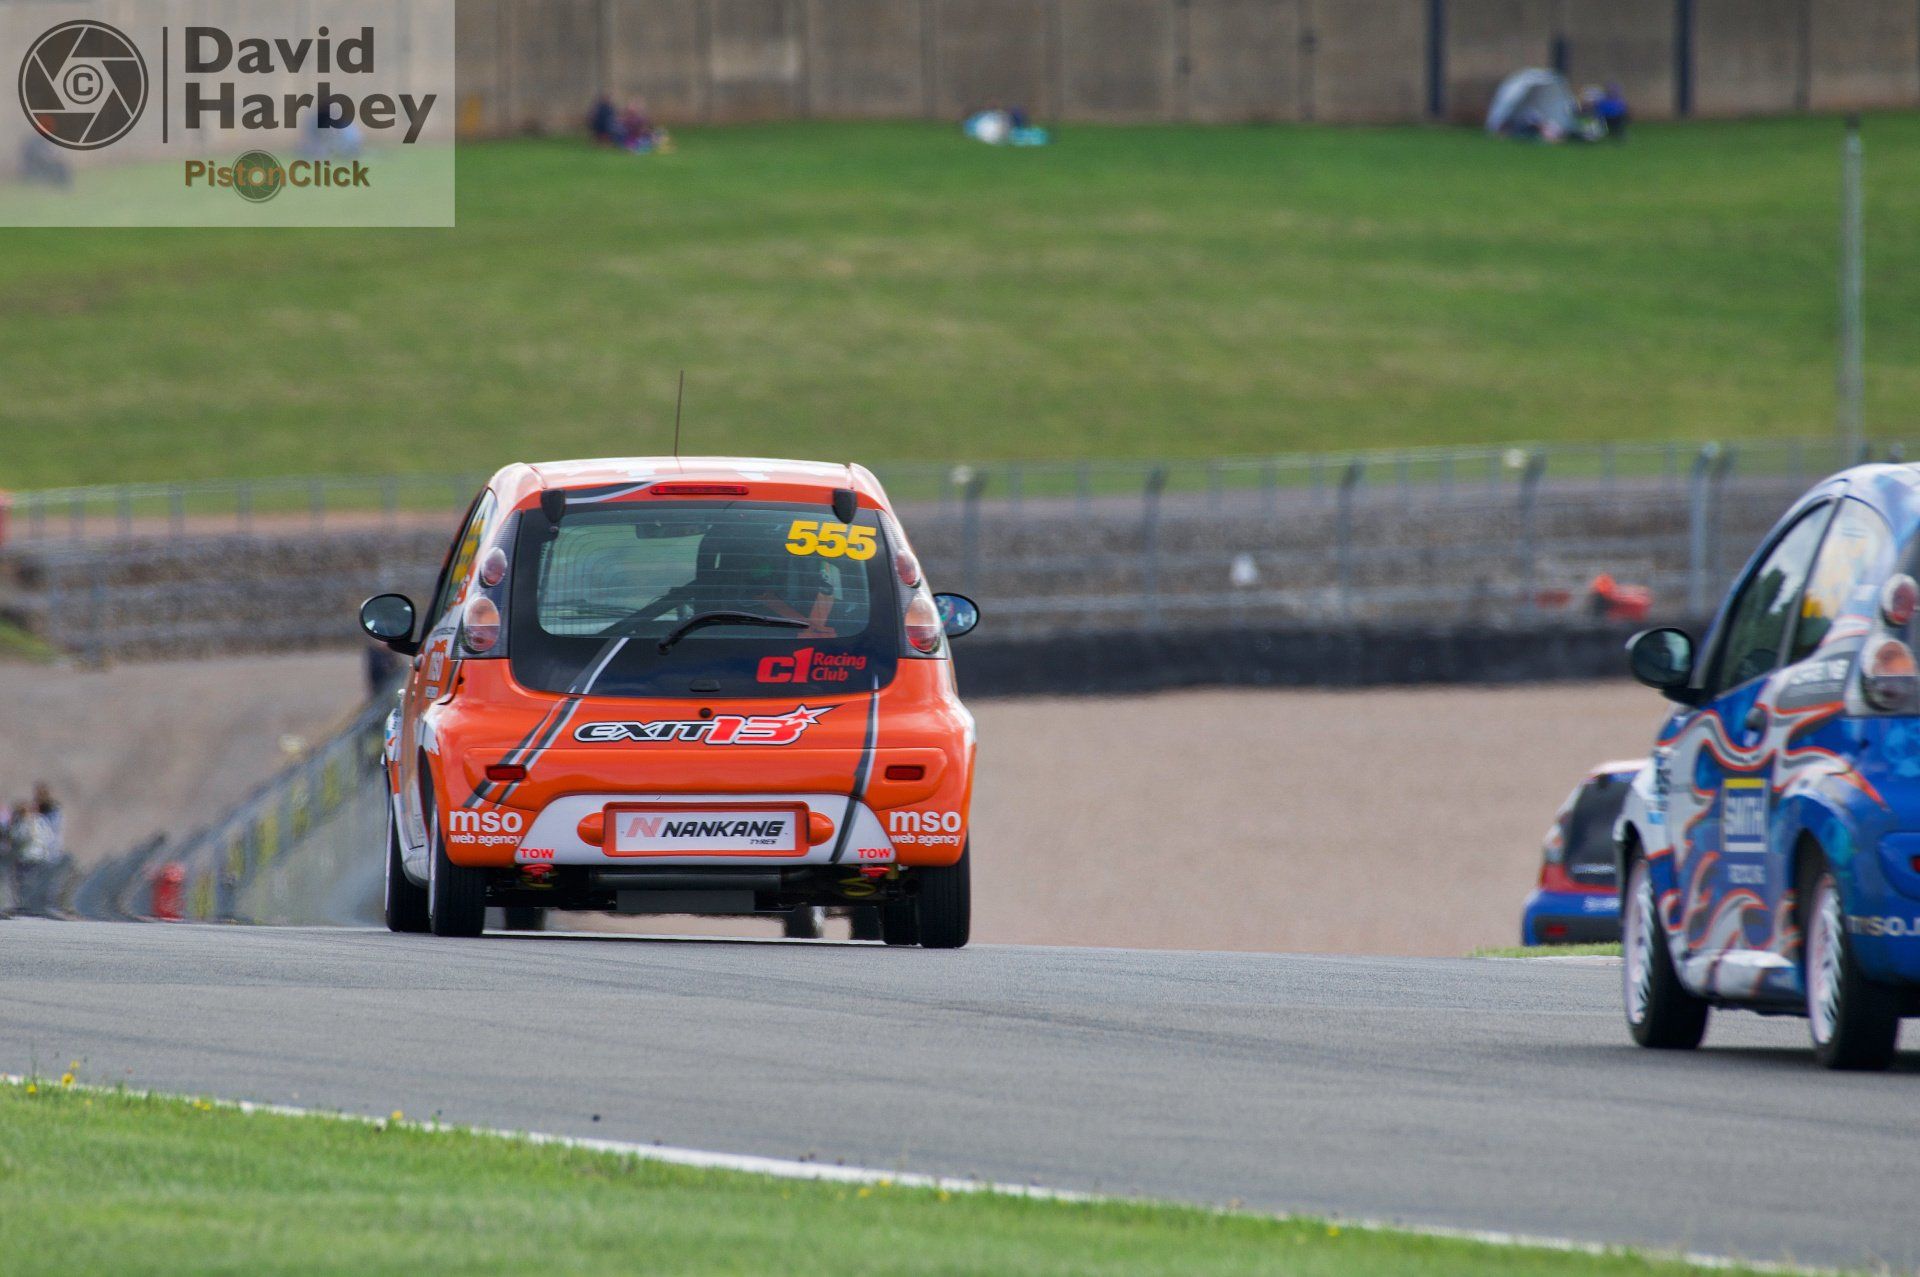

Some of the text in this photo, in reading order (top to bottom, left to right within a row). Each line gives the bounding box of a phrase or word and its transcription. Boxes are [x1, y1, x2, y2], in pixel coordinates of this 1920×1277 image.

[785, 520, 877, 560] 555
[813, 652, 867, 669] Racing
[811, 667, 849, 682] Club
[449, 810, 523, 832] mso
[890, 810, 962, 833] mso
[662, 820, 786, 838] NANKANG
[450, 832, 523, 847] web agency
[749, 838, 778, 846] TYRES
[891, 833, 961, 847] web agency
[520, 848, 555, 859] TOW
[857, 847, 892, 859] TOW
